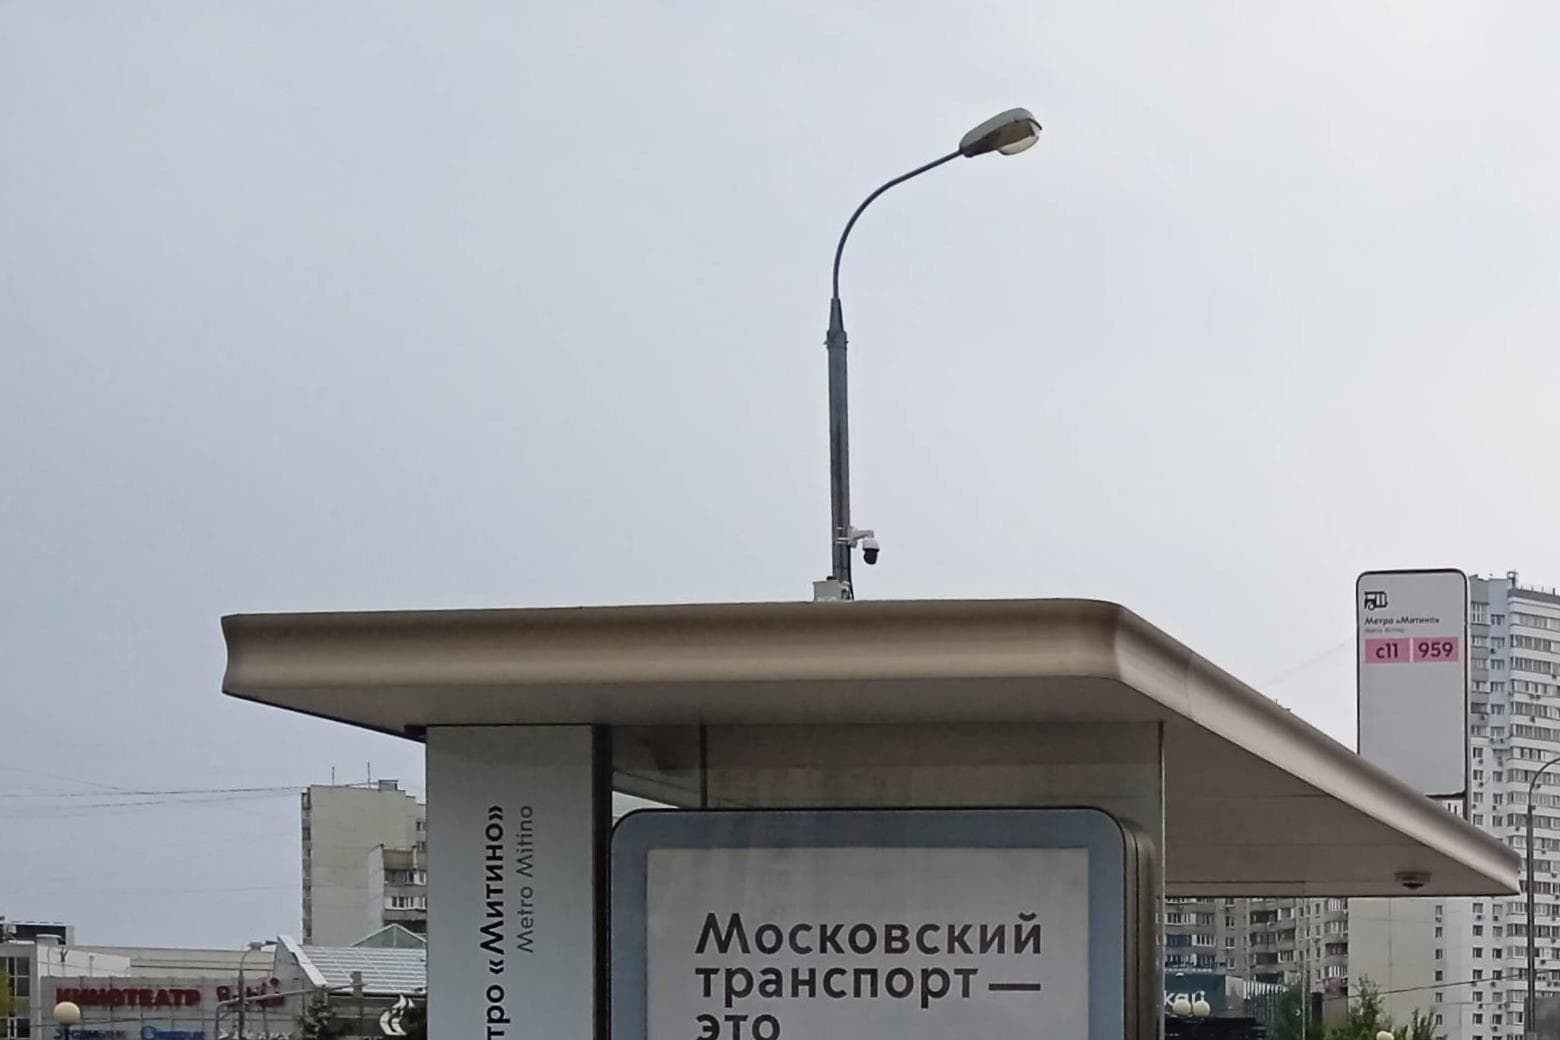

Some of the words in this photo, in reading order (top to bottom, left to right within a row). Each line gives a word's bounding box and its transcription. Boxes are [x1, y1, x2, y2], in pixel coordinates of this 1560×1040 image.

[1418, 641, 1453, 658] 959
[516, 805, 534, 877] Mitino
[480, 804, 505, 975] «Митино»
[516, 886, 534, 953] Metro
[695, 911, 1041, 955] Московский
[695, 966, 979, 1009] транспорт
